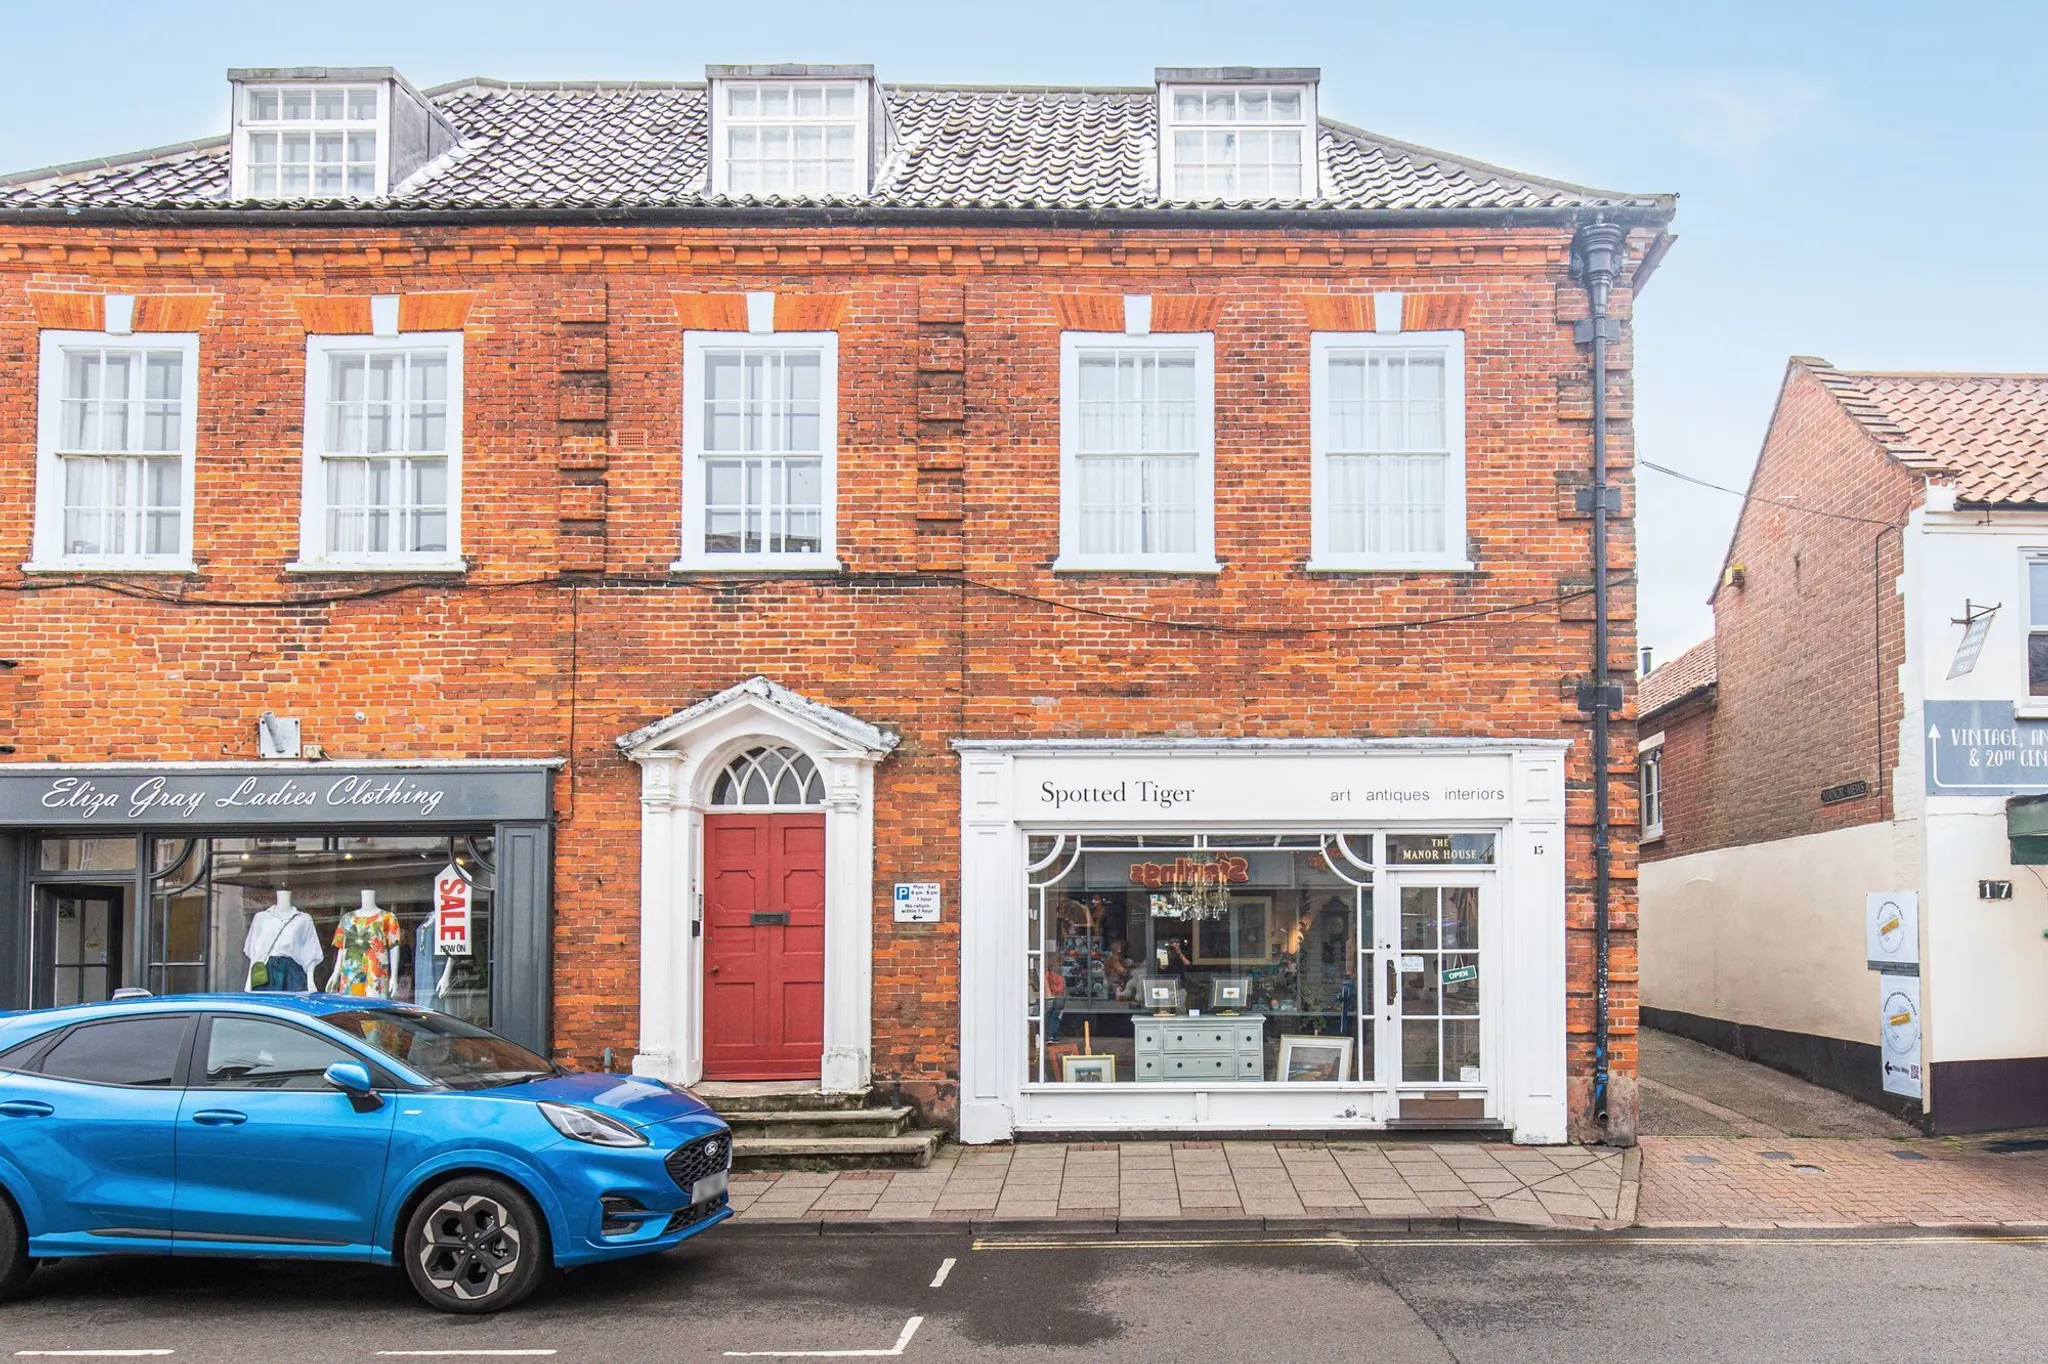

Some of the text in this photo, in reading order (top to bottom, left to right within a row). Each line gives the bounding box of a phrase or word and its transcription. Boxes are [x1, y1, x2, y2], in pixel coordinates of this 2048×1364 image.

[1951, 728, 2023, 748] VINTAGE,
[1969, 748, 2048, 767] & 20TH CEN
[41, 775, 444, 818] Eliza Gray Ladies Clothing
[1041, 780, 1195, 808] Spotted Tiger
[1330, 787, 1505, 803] art antiques interiors
[1431, 838, 1449, 847] THE
[1534, 845, 1544, 855] 15
[1403, 849, 1477, 860] MANOR HOUSE
[1984, 882, 2010, 899] 17
[439, 878, 466, 941] SALE
[457, 944, 466, 953] ON
[1448, 969, 1469, 980] OPEN
